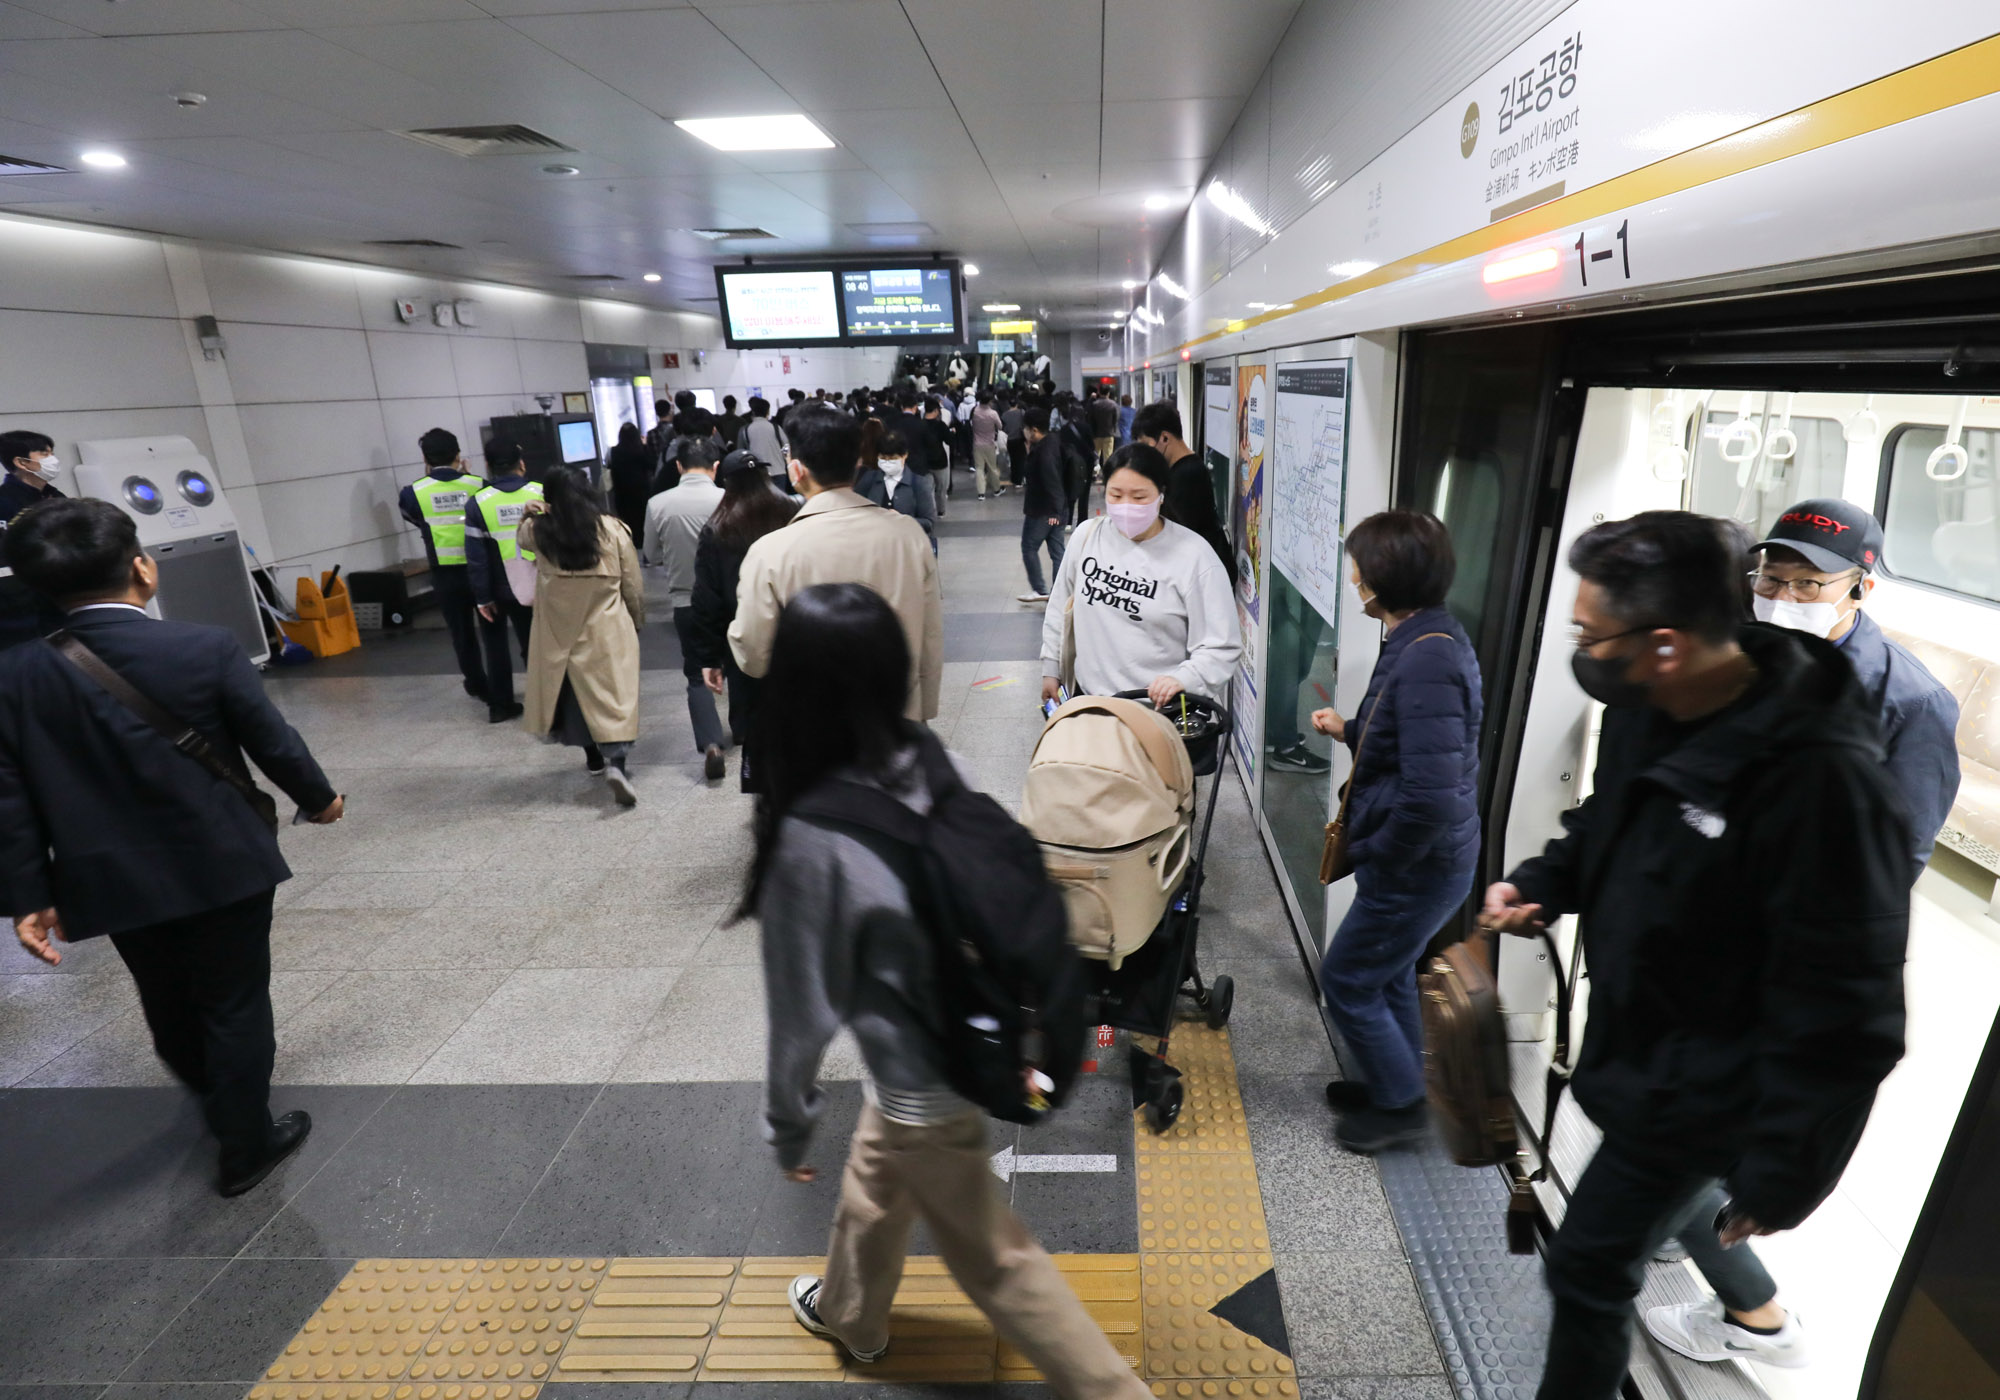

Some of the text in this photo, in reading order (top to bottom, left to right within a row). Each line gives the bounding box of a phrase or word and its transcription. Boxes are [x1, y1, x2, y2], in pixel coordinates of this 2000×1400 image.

[1498, 30, 1583, 135] 김포공항
[1461, 117, 1480, 143] G109
[1490, 104, 1580, 169] Gimpo Int'l Airport
[1528, 138, 1580, 183] キンポ空港
[1485, 167, 1520, 203] 金浦机场
[1575, 218, 1631, 287] 1-1
[1780, 512, 1851, 533] RUDY
[1081, 556, 1158, 600] Original
[1081, 576, 1141, 614] Sports
